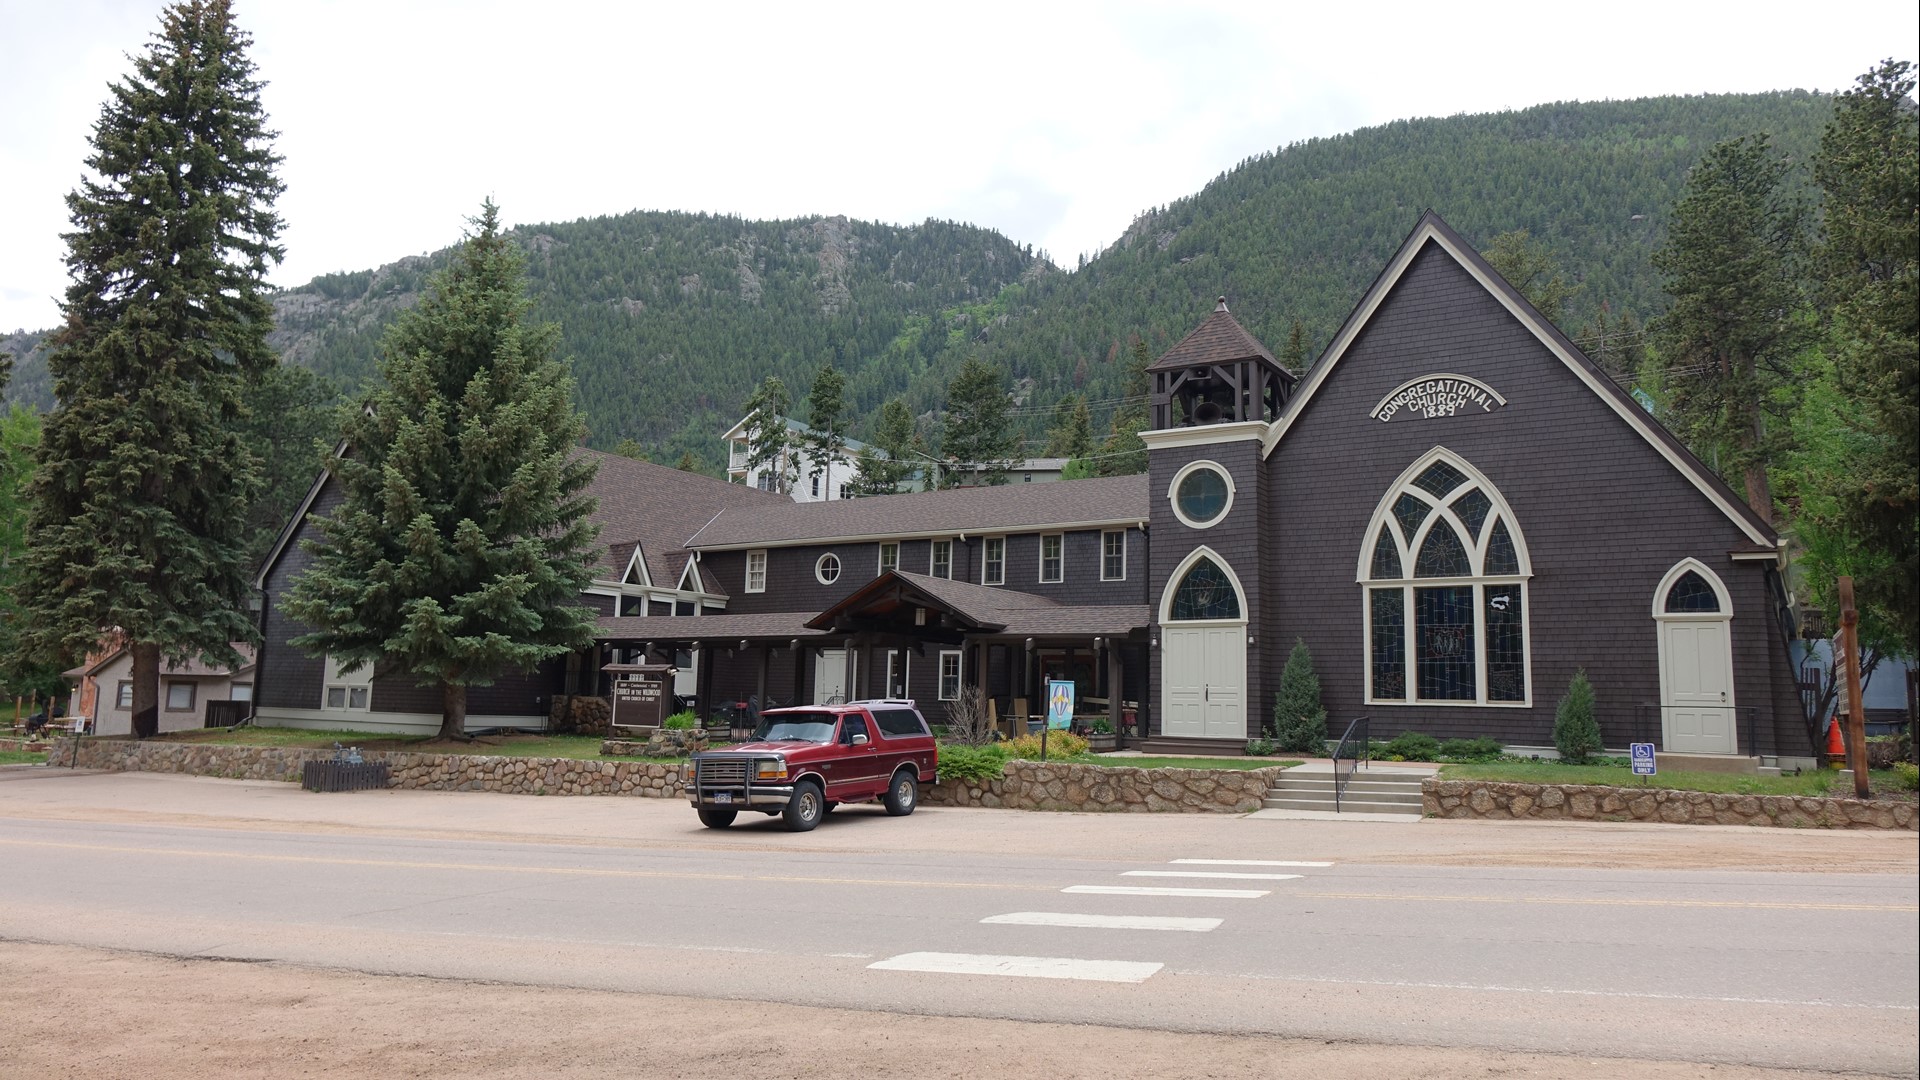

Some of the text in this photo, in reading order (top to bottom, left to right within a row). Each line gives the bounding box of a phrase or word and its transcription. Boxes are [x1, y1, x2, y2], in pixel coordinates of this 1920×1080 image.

[1378, 380, 1492, 422] CONGREGATIONAL
[1408, 393, 1467, 412] CHURCH
[1422, 404, 1456, 419] 1889
